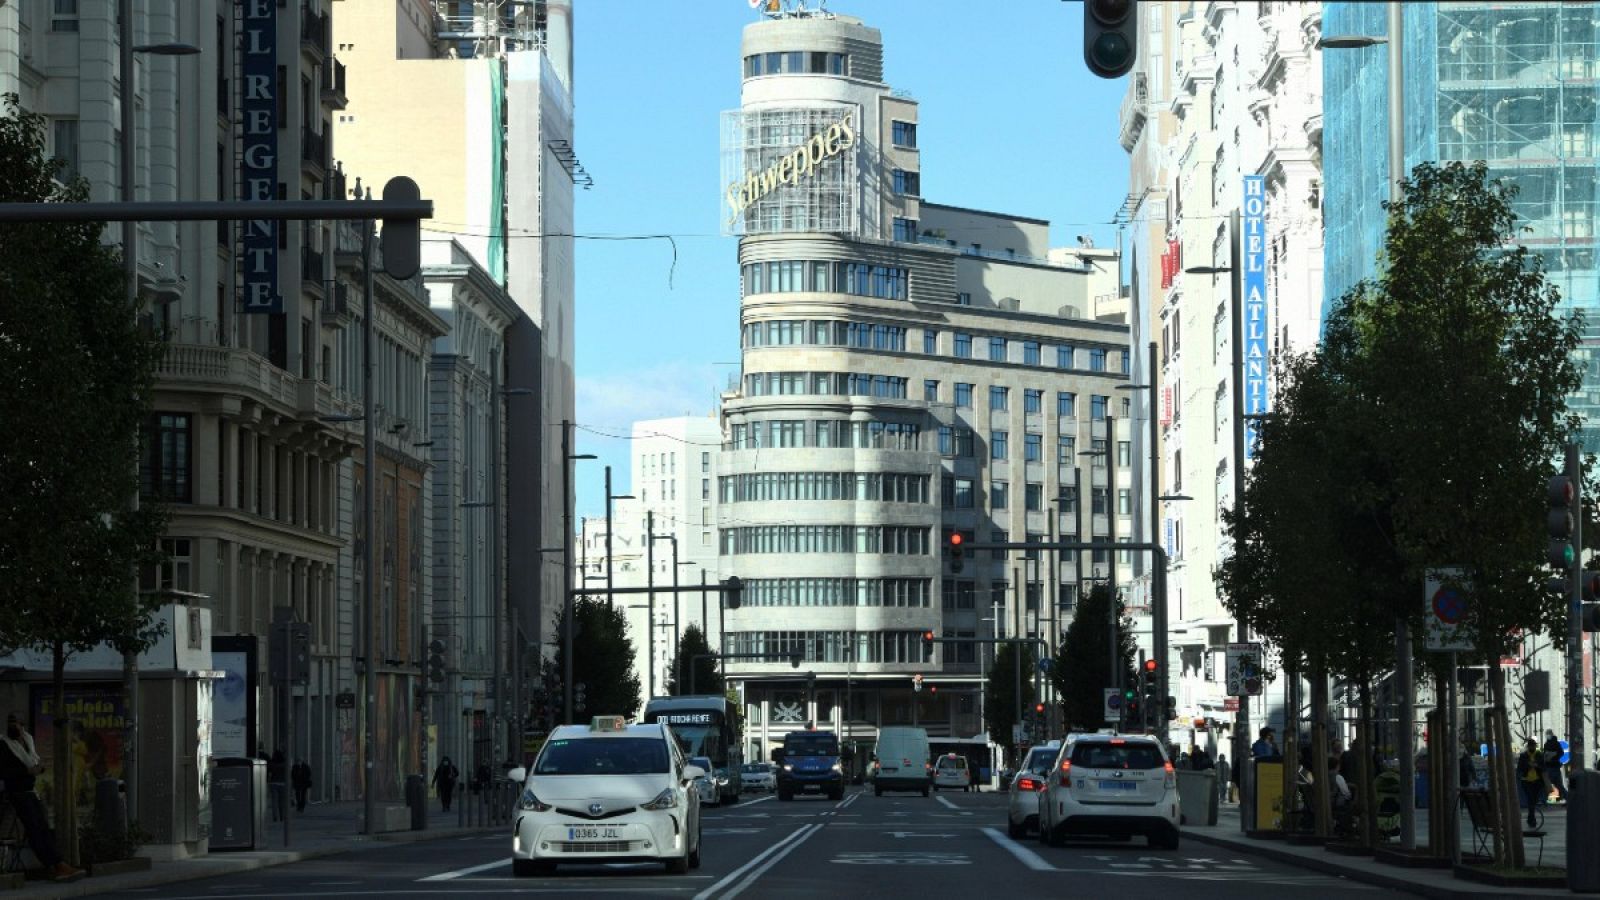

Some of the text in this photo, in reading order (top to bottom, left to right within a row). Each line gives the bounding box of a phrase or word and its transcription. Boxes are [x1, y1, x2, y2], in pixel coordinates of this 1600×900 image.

[244, 74, 275, 307] REGENTE
[726, 112, 854, 225] Schweppes
[1246, 179, 1265, 450] HOTEL ATLANTI
[575, 828, 619, 838] 0365 JZL
